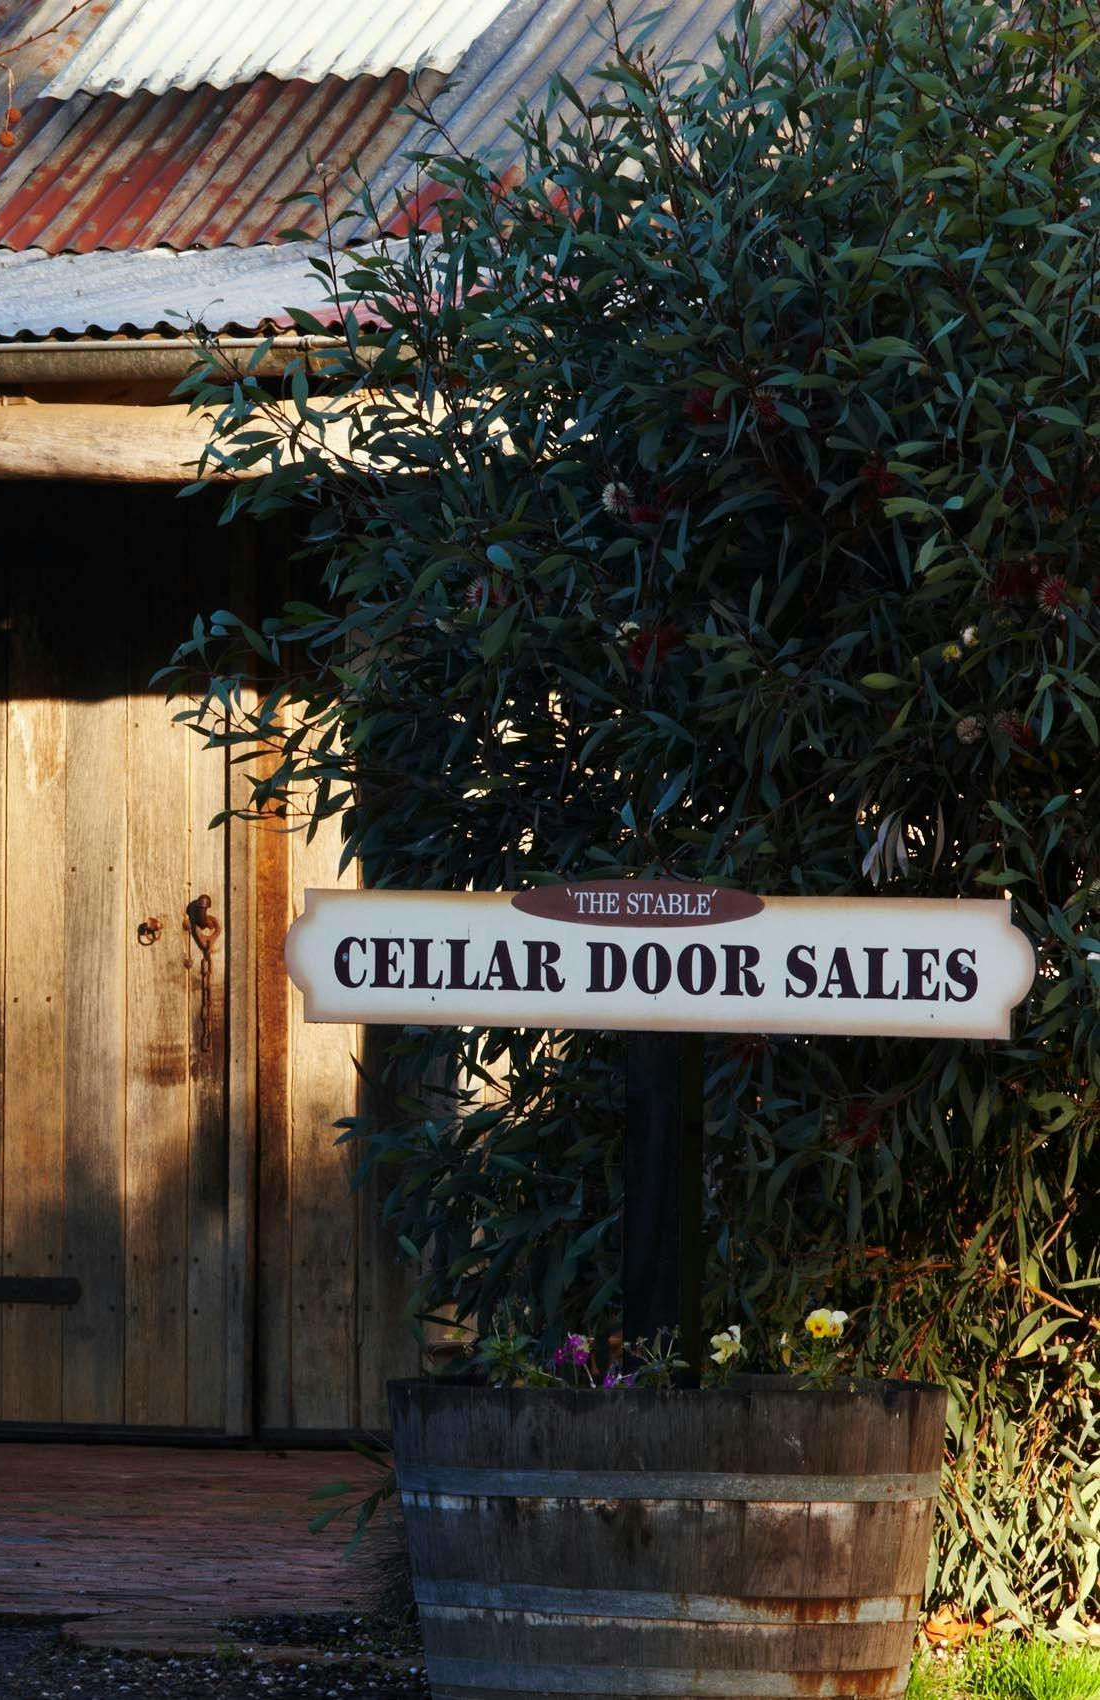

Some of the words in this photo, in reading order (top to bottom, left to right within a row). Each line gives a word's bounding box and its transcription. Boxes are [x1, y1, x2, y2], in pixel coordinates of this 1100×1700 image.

[333, 936, 567, 993] CELLAR
[585, 941, 766, 998] DOOR
[784, 944, 979, 1003] SALES
